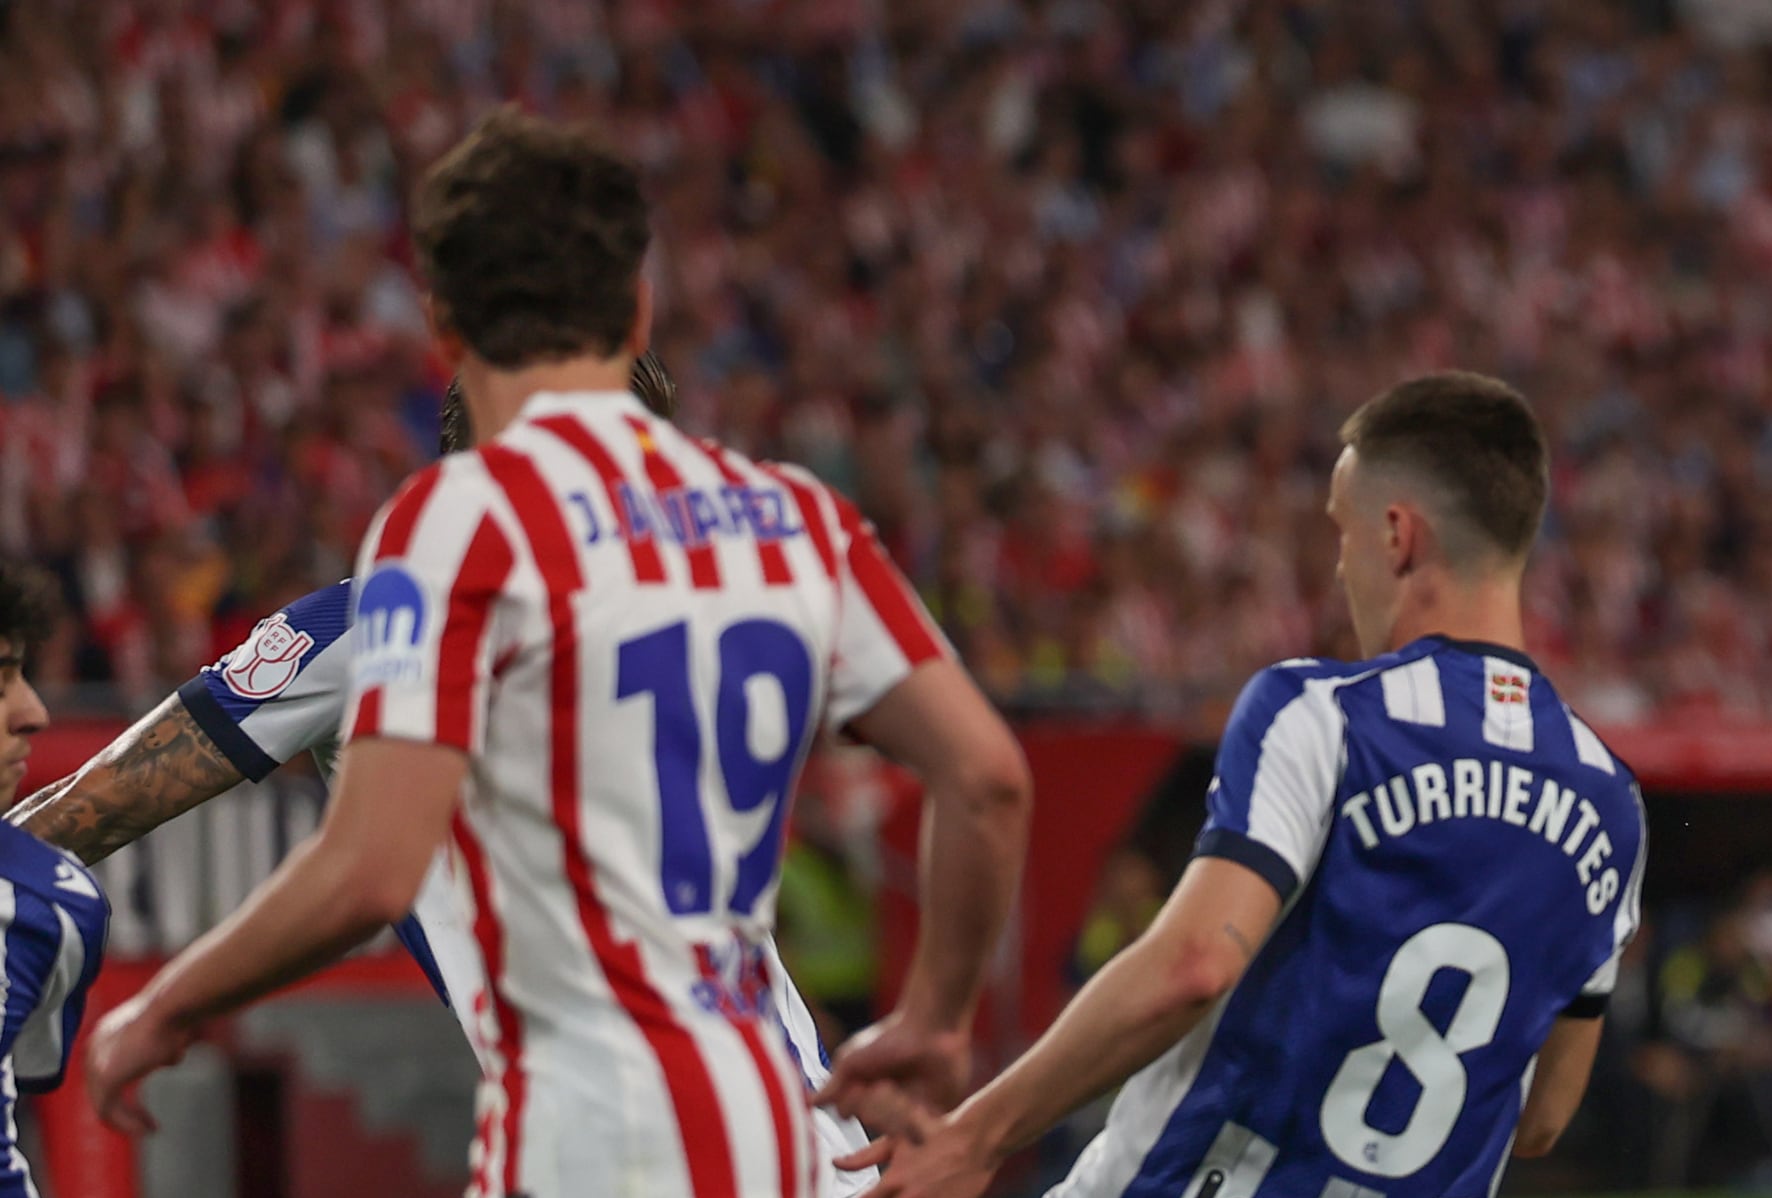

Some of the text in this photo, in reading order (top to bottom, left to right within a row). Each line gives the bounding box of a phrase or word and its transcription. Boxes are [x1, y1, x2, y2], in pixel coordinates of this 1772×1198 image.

[616, 618, 813, 916] 19
[1341, 758, 1620, 916] TURRIENTES
[1319, 922, 1511, 1179] 8
